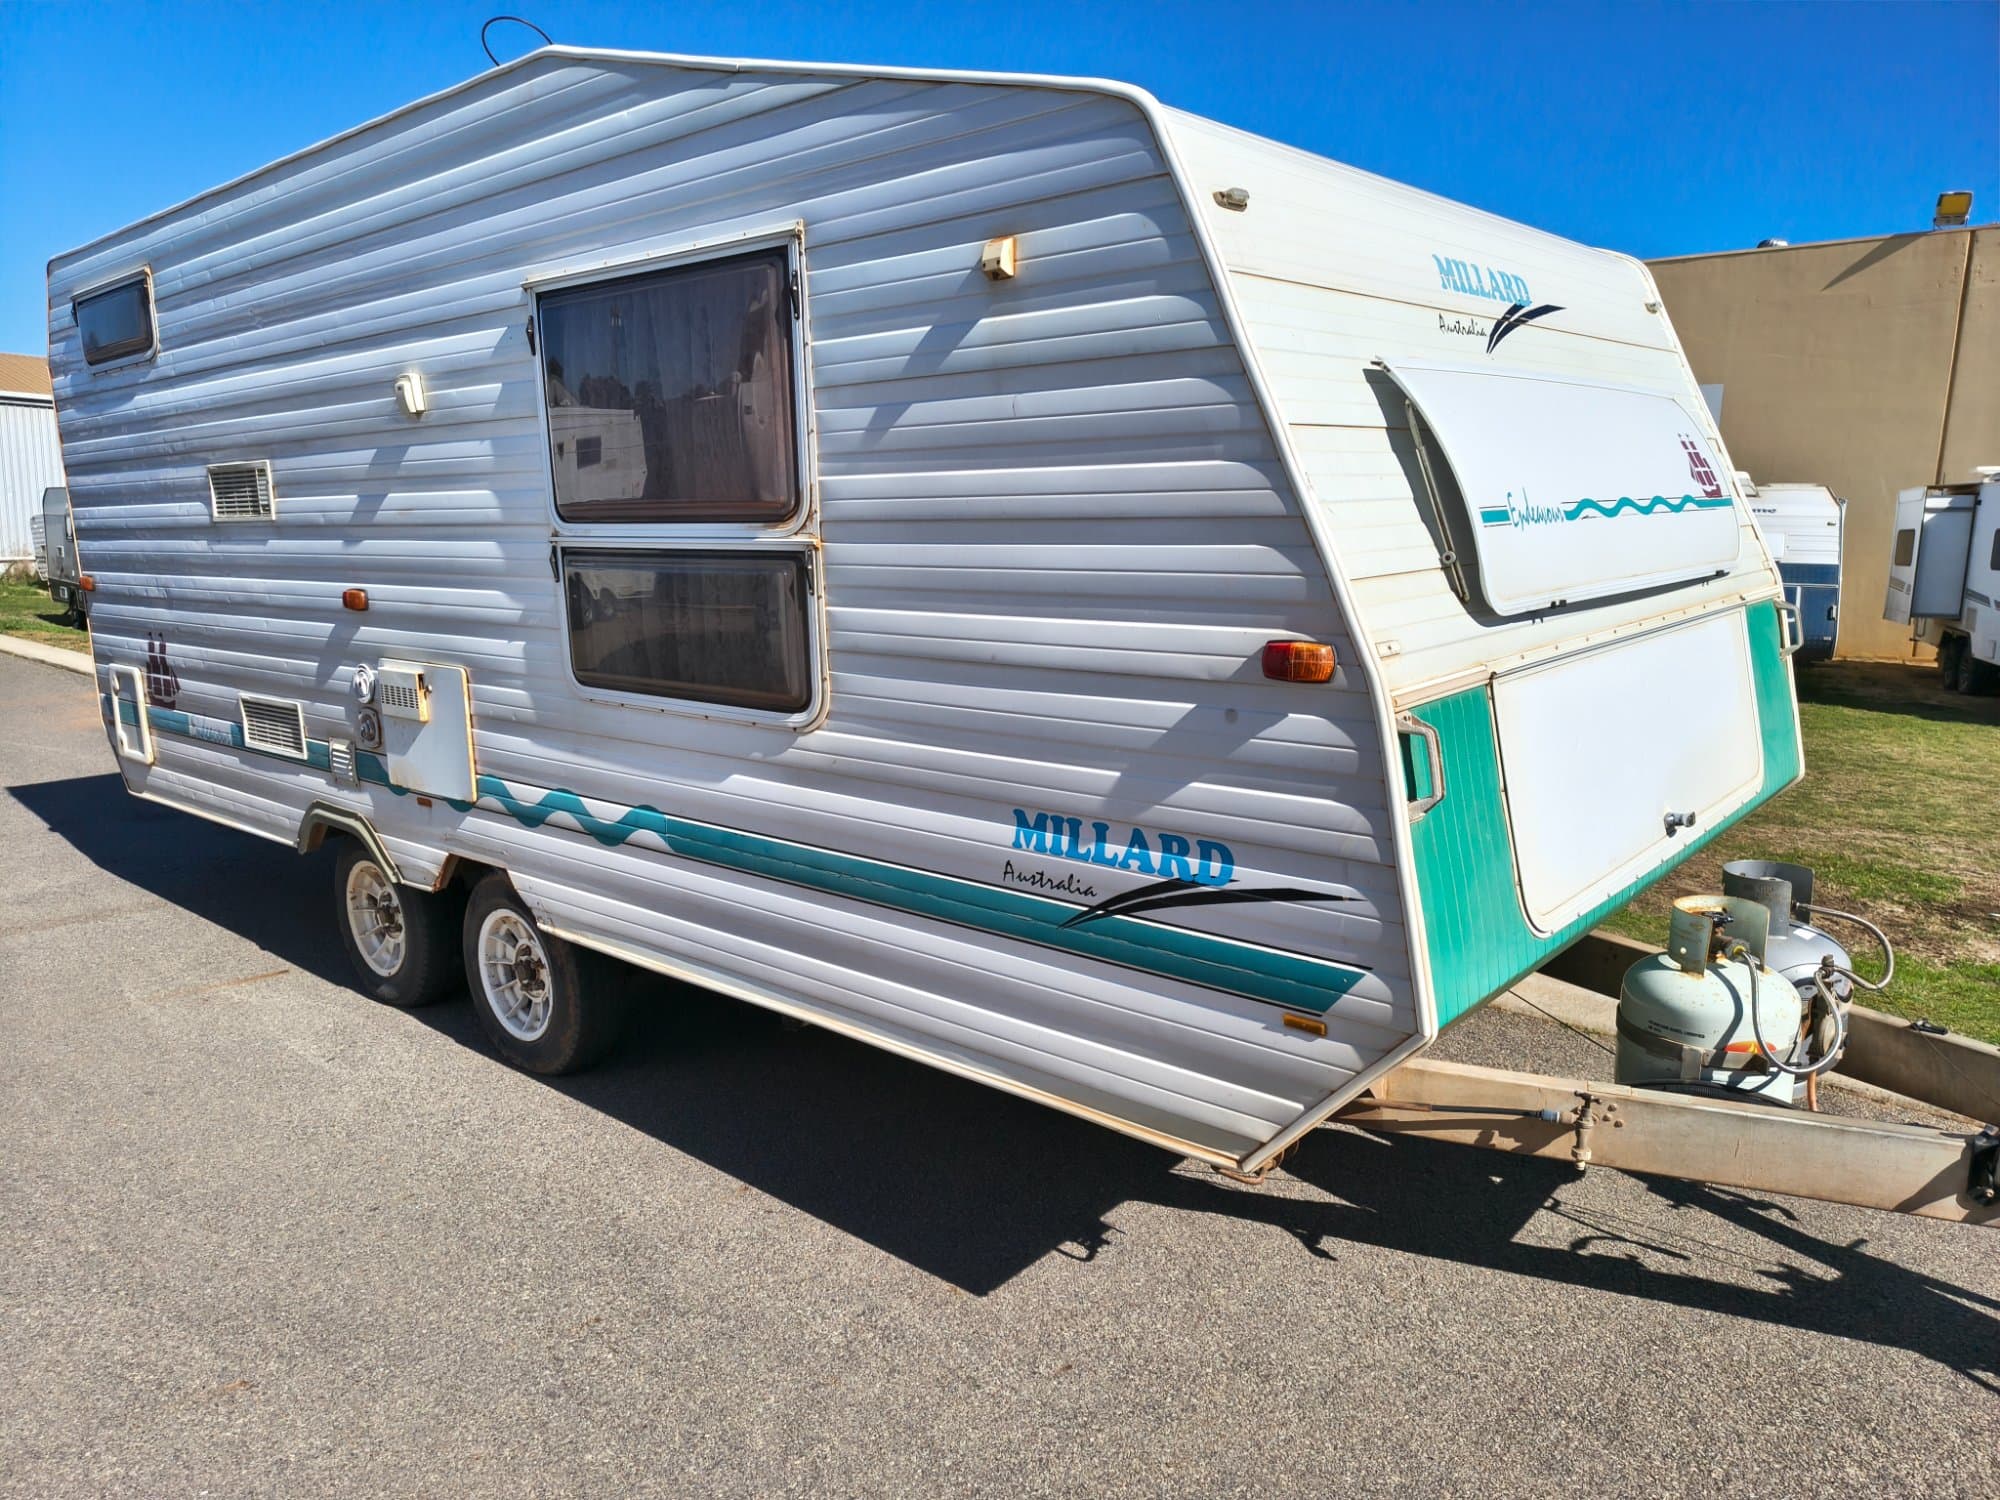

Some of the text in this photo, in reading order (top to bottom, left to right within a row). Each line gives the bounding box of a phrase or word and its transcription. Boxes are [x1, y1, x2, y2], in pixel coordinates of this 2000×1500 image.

[1432, 254, 1532, 306] MILLARD
[1439, 312, 1487, 337] Australia
[1012, 808, 1234, 887] MILLARD
[1003, 859, 1098, 898] Australia
